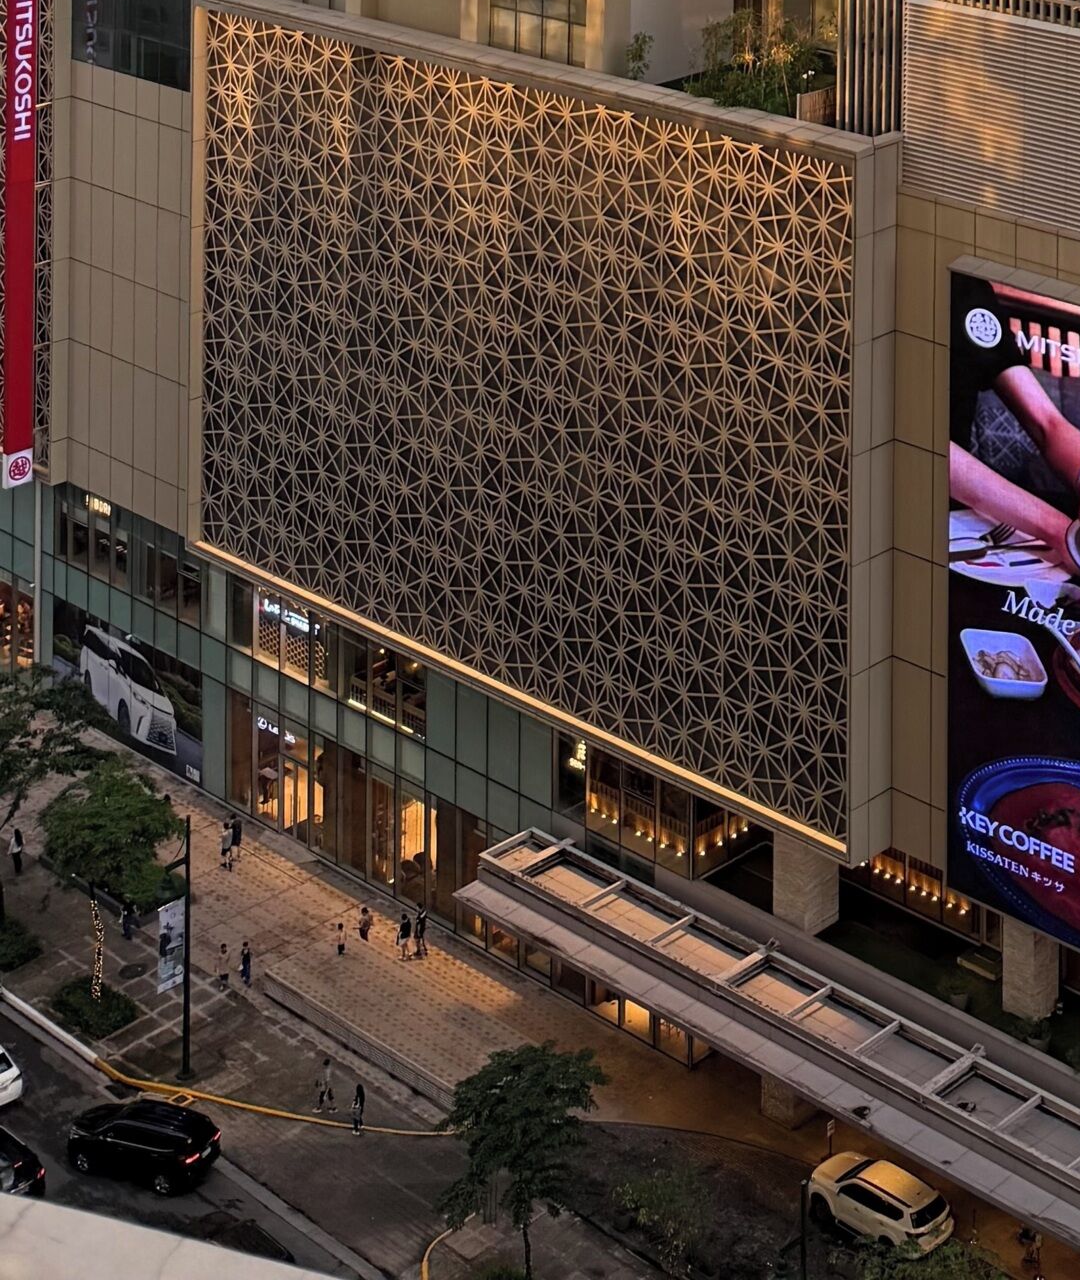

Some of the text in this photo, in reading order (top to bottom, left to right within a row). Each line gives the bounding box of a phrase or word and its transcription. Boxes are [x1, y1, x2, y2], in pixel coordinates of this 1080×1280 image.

[1001, 590, 1075, 636] Made
[959, 807, 1075, 873] KEY COFFEE
[967, 841, 1029, 878] KISSATEN
